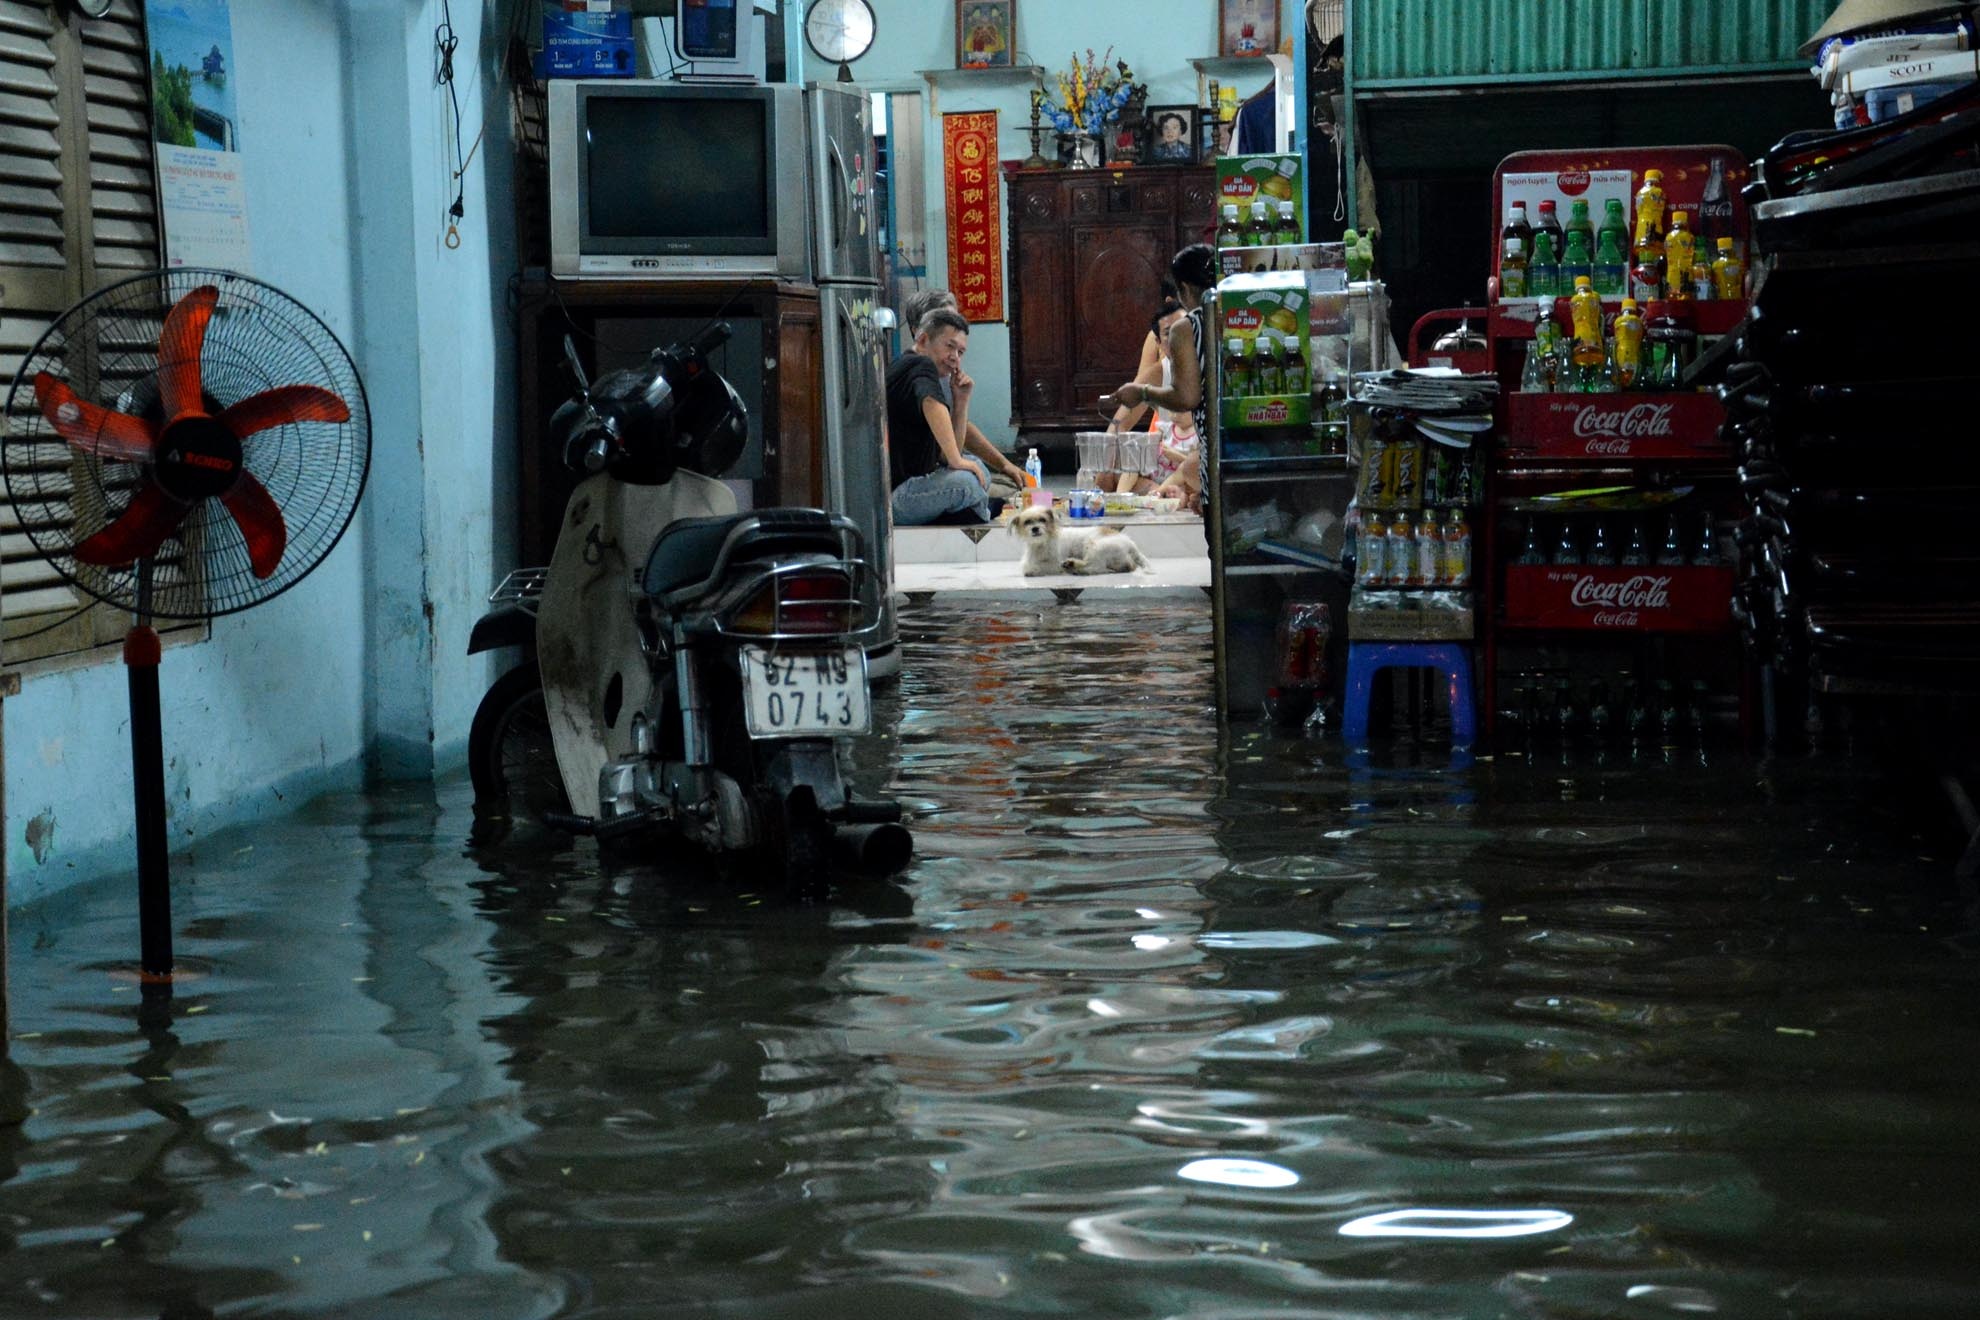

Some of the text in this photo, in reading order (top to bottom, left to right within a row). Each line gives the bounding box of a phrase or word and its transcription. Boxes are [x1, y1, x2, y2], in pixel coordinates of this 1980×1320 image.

[1886, 54, 1912, 63] JET
[1889, 61, 1935, 77] SCOTT
[1573, 402, 1675, 437] Coca-Cola
[1584, 438, 1632, 454] Coca-Cola
[1570, 575, 1673, 608] Coca-Cola
[1592, 610, 1639, 626] Coca-Cola
[767, 690, 852, 726] 0743
